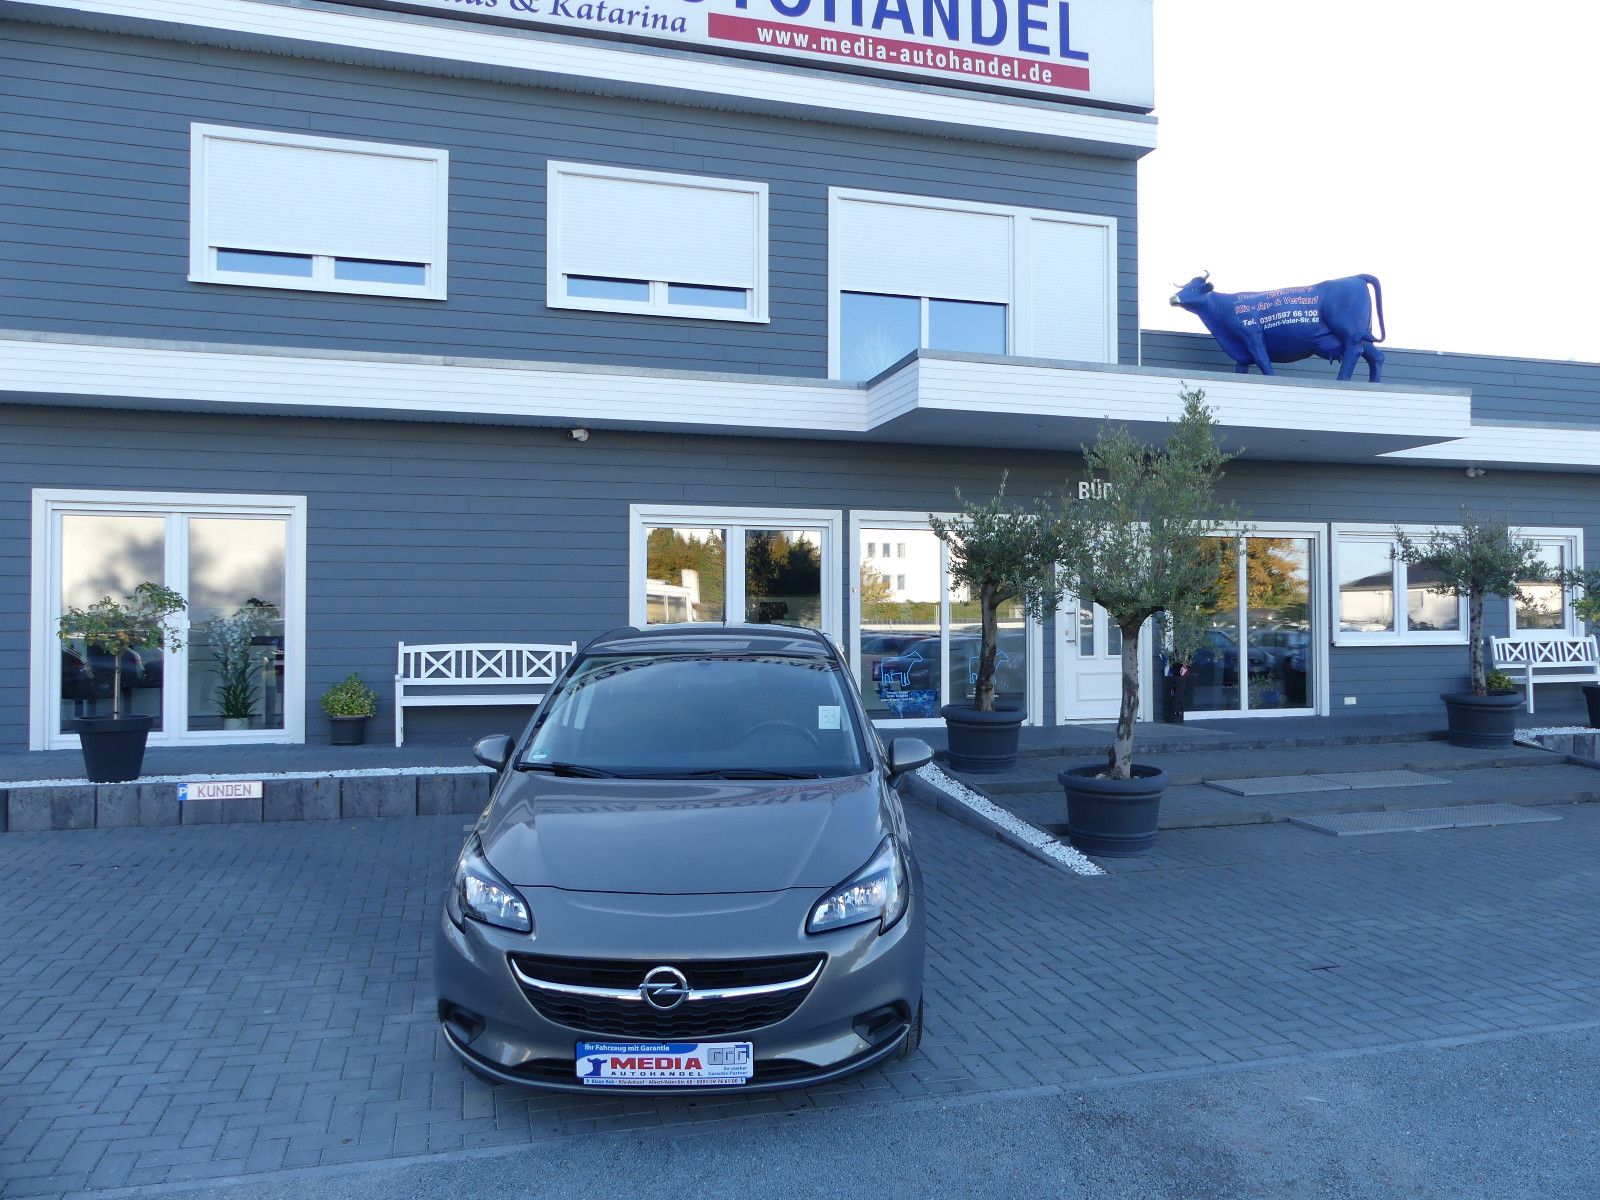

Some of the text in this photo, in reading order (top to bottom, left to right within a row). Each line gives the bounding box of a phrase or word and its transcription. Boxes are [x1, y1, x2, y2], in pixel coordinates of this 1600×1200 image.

[548, 0, 687, 33] Katarina
[757, 27, 1053, 83] www.media-autohandel.de
[1243, 318, 1257, 326] Tel.
[1304, 309, 1318, 317] 100
[197, 784, 252, 798] KUNDEN
[595, 1045, 627, 1053] Fahrzeug
[610, 1057, 703, 1070] MEDIA
